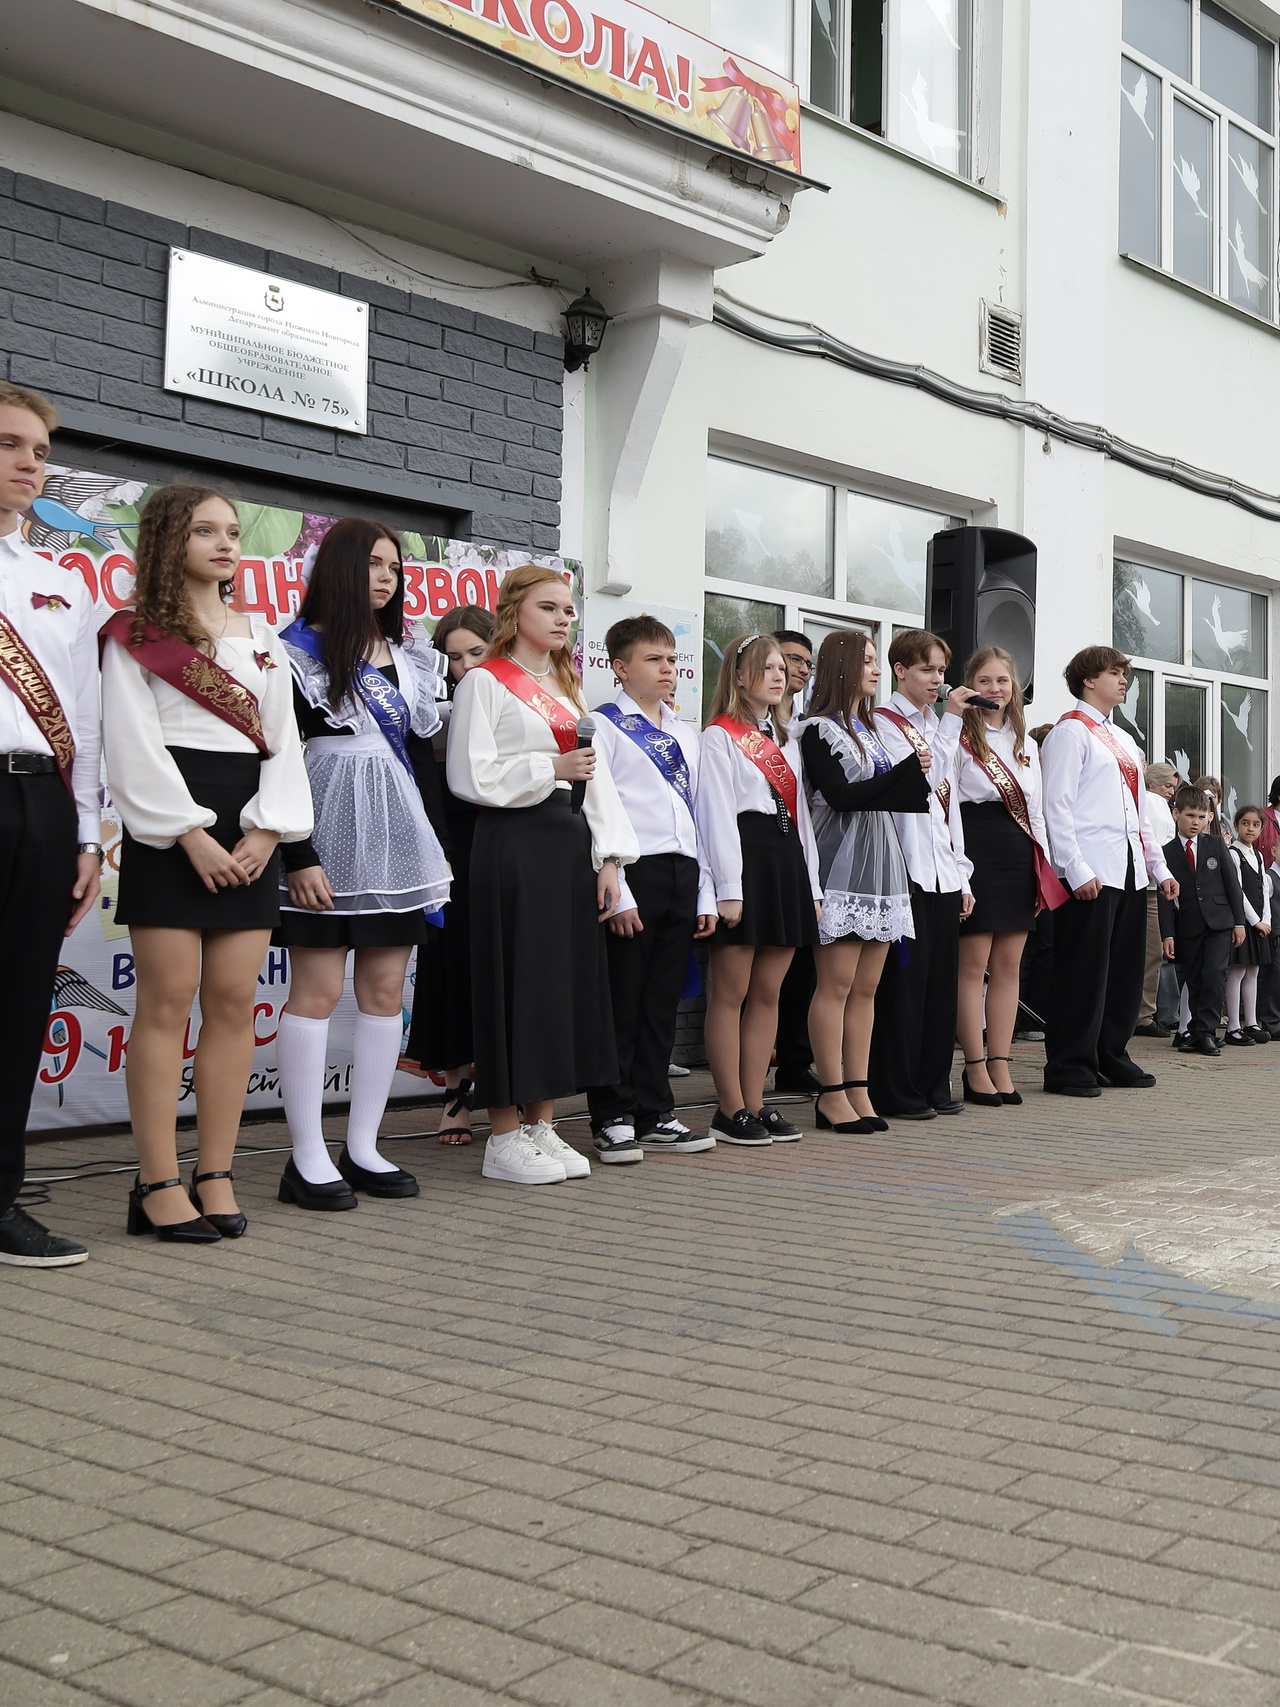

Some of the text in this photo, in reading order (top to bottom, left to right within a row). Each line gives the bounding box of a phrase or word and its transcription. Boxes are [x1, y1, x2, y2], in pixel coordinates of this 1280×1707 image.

[227, 315, 328, 347] Департамент образования
[257, 313, 284, 326] города
[208, 340, 333, 378] ОБЩЕОБРАЗОВАТЕЛЬНОЕ
[237, 357, 306, 380] УЧРЕЖДЕНИЕ
[286, 350, 350, 373] БЮДЖЕТНОЕ
[186, 367, 350, 417] «ШКОЛА № 75»
